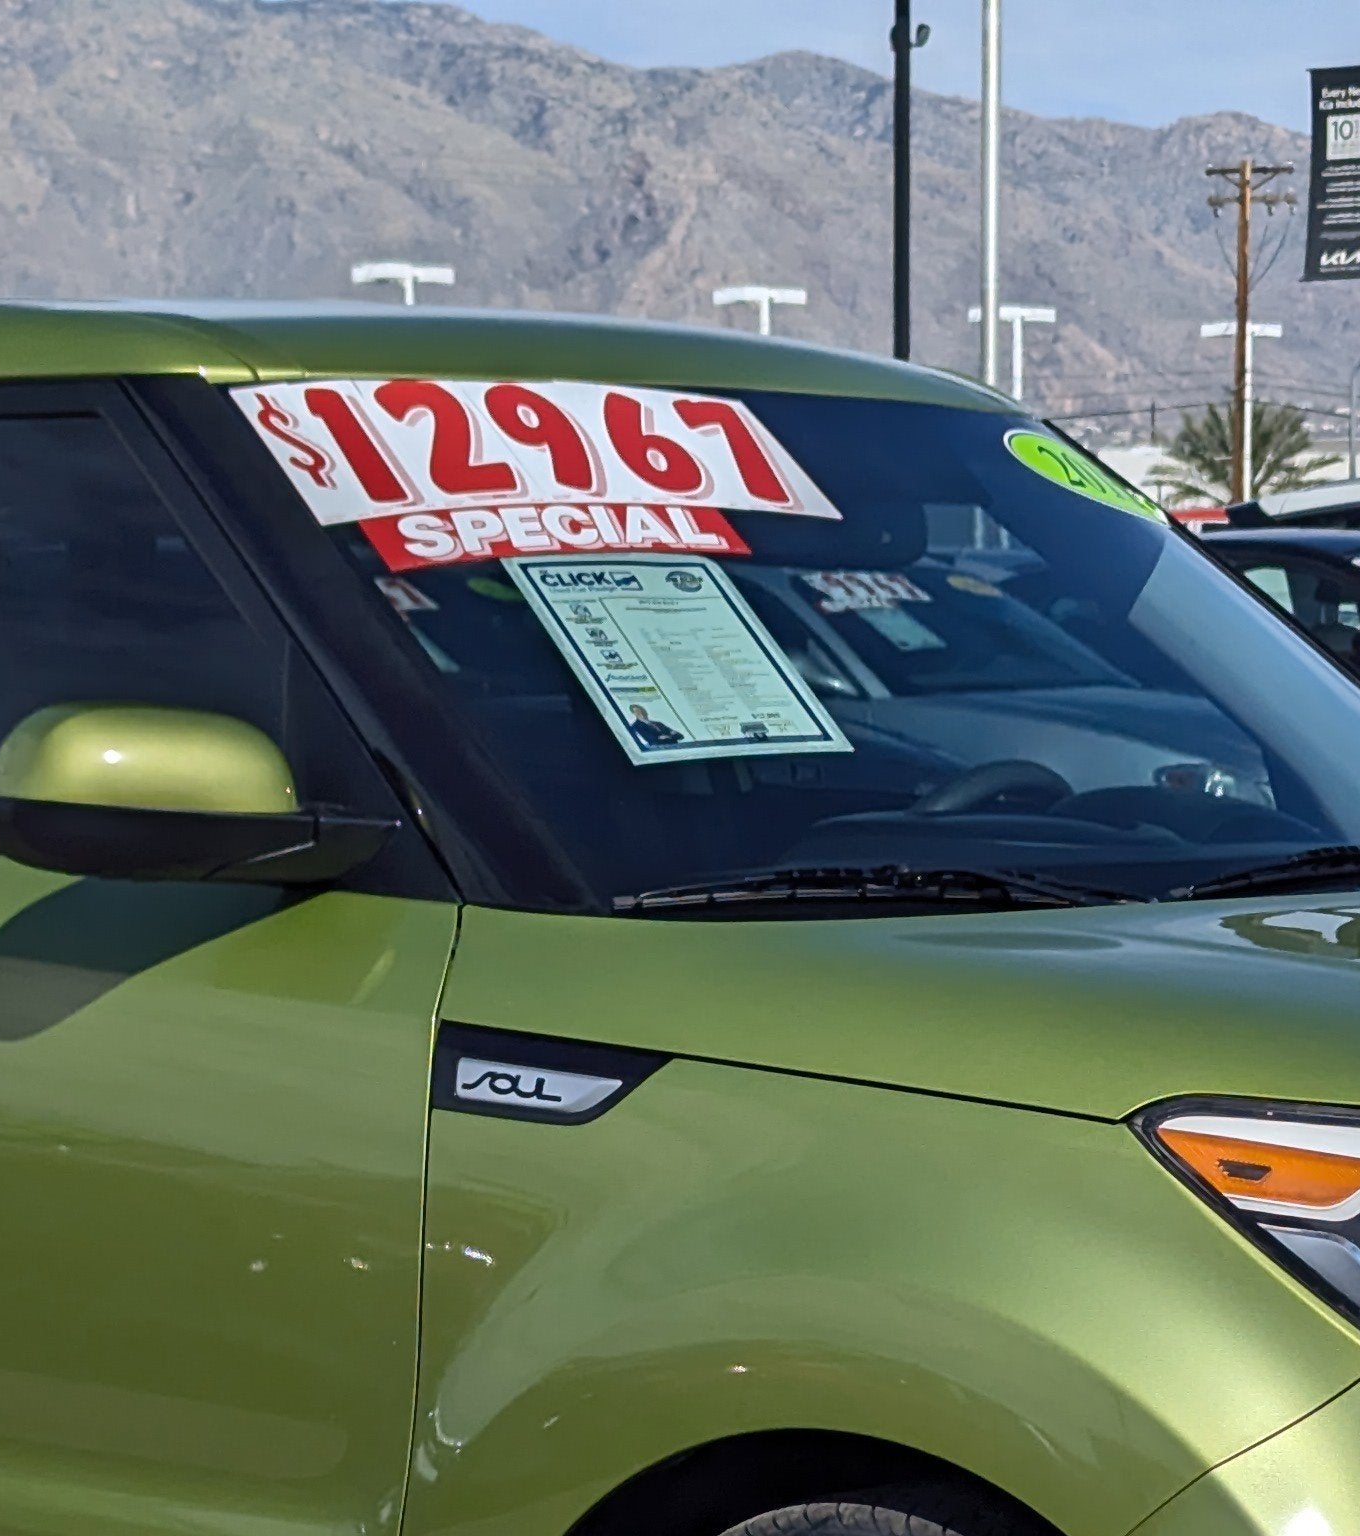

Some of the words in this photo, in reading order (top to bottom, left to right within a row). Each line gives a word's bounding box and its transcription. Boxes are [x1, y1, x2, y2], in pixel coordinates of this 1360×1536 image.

[1330, 120, 1354, 141] 10
[256, 380, 798, 505] $12967
[396, 504, 728, 560] SPECIAL
[540, 571, 612, 587] CLICK
